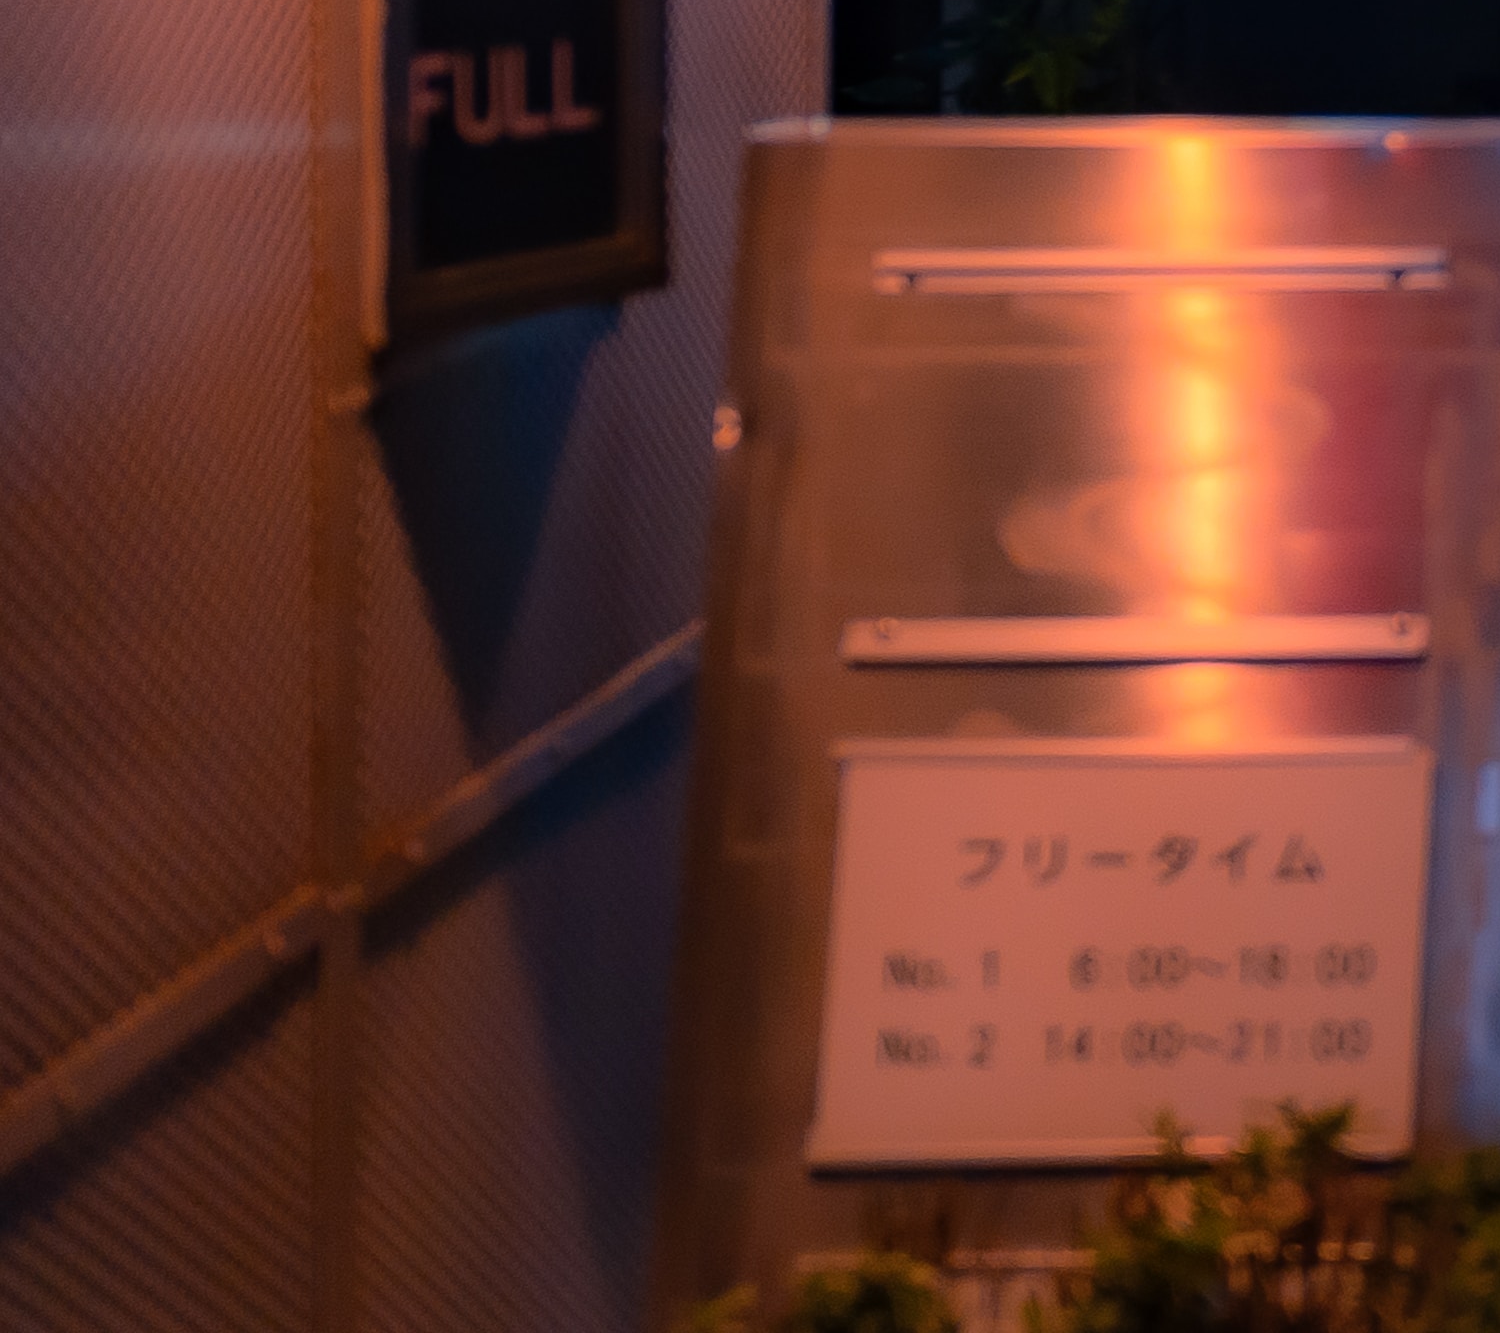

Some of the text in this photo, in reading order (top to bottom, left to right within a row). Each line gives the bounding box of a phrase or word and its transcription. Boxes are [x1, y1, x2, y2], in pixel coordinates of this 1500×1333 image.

[406, 36, 600, 147] FULL
[959, 835, 1325, 884] フリータイム
